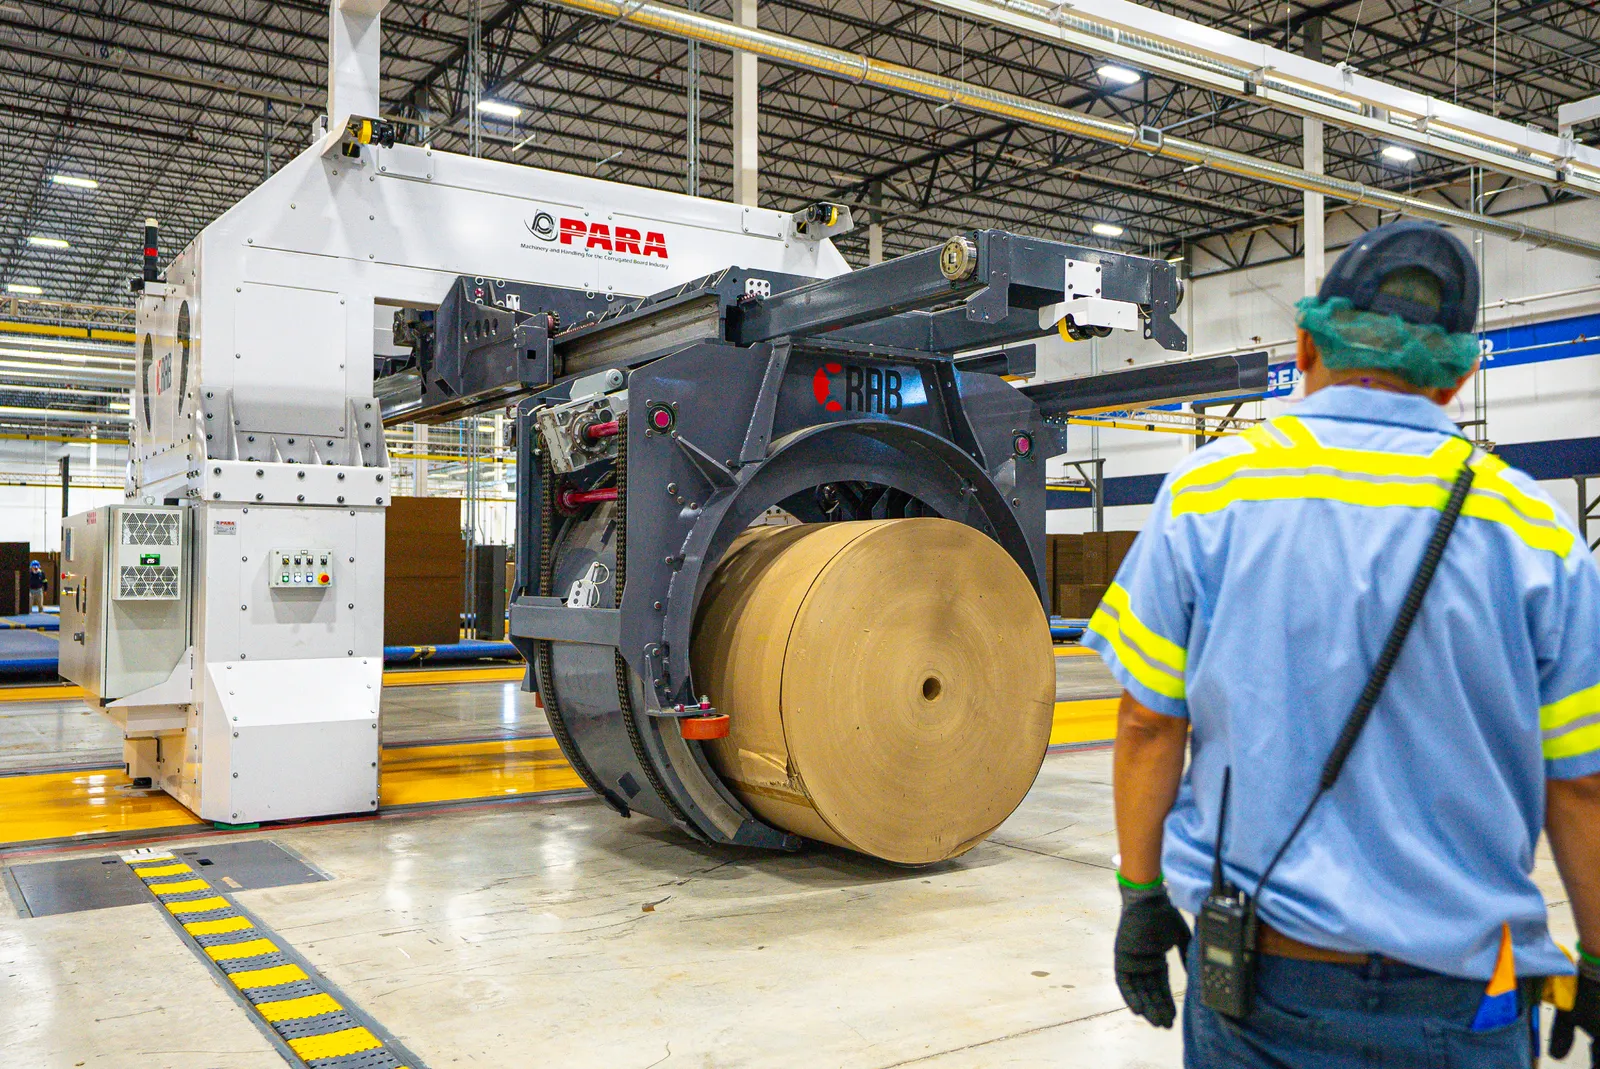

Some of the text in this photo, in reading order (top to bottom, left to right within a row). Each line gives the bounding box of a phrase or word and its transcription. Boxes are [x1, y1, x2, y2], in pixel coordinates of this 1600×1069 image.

[560, 217, 668, 259] PARA
[520, 243, 549, 252] Machinery
[560, 249, 585, 258] Handling
[604, 255, 632, 263] Corrugated
[648, 262, 669, 270] Industry
